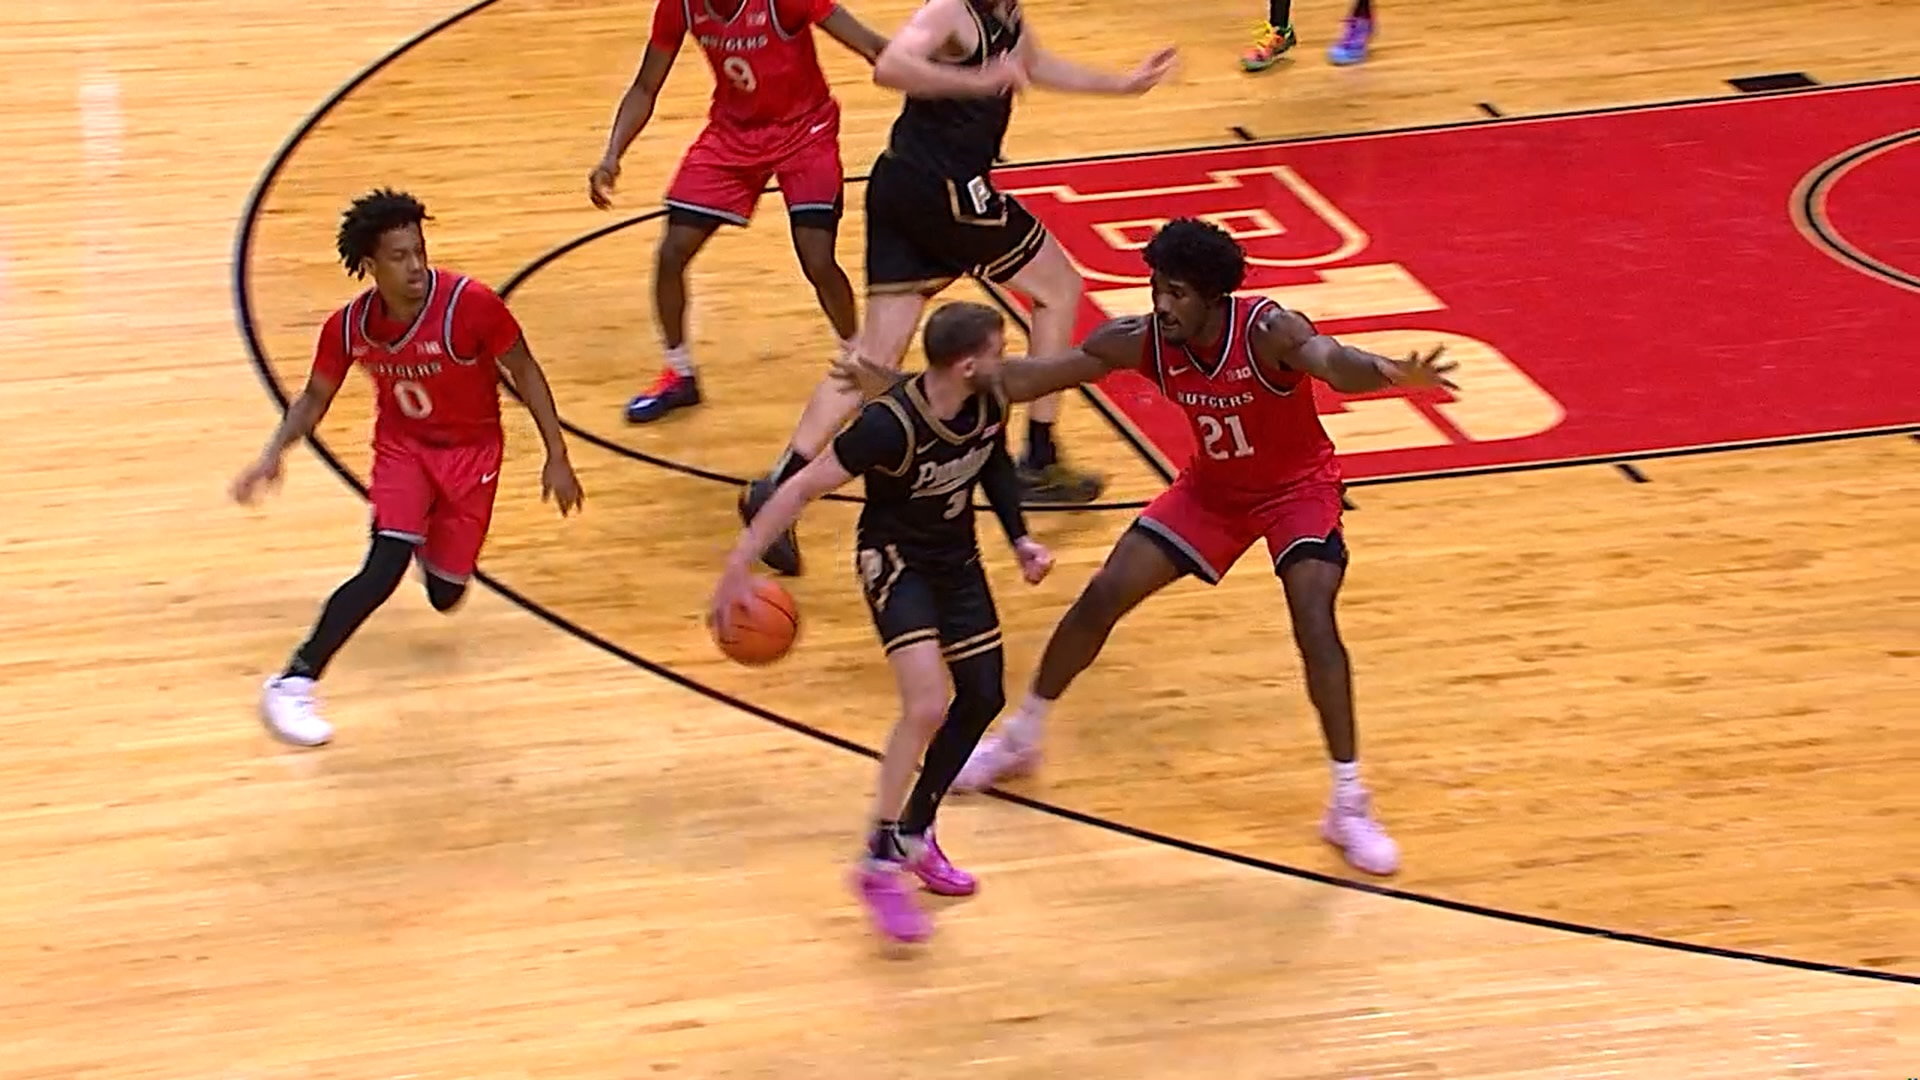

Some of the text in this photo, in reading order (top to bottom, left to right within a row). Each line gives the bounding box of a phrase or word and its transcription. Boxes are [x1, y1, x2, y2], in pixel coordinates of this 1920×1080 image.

[723, 56, 757, 92] 9
[394, 379, 433, 419] 0
[1177, 391, 1255, 409] RUTGERS
[1197, 415, 1255, 460] 21
